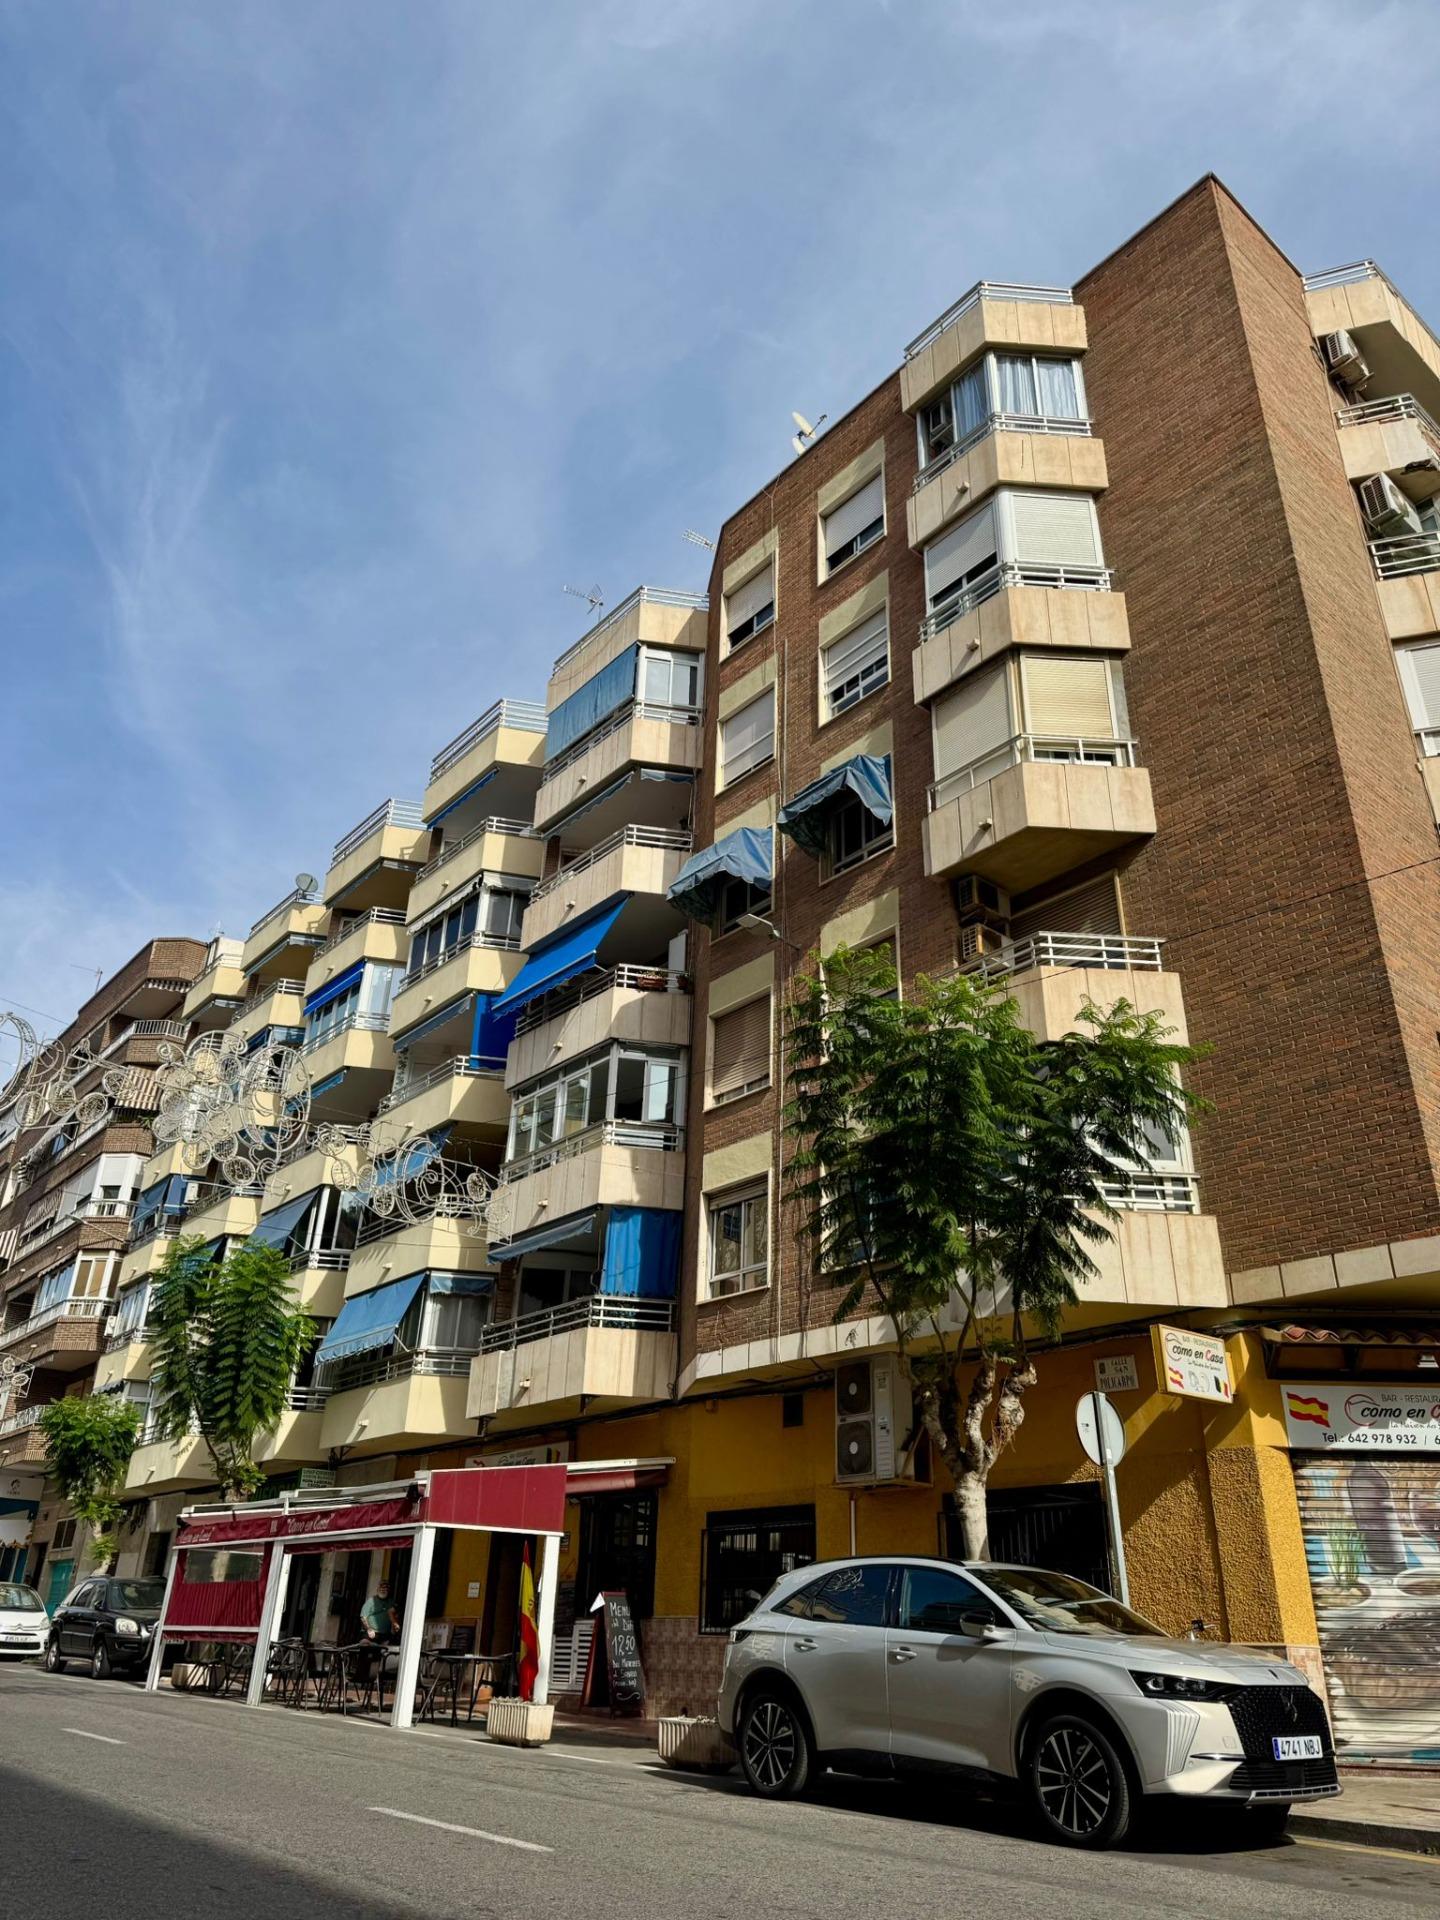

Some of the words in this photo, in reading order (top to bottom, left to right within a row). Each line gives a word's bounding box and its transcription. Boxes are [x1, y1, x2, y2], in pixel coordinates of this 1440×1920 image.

[1172, 1345, 1193, 1357] como
[1194, 1350, 1204, 1359] en
[1205, 1349, 1224, 1364] Casa
[1381, 1394, 1397, 1402] BAR
[1404, 1394, 1440, 1403] RESTAUR
[1360, 1406, 1402, 1418] como
[1407, 1408, 1426, 1418] en
[1348, 1434, 1369, 1443] 642
[1371, 1434, 1393, 1444] 978
[1396, 1435, 1417, 1444] 932
[1281, 1740, 1302, 1757] 4741
[1303, 1739, 1320, 1756] NBJ
